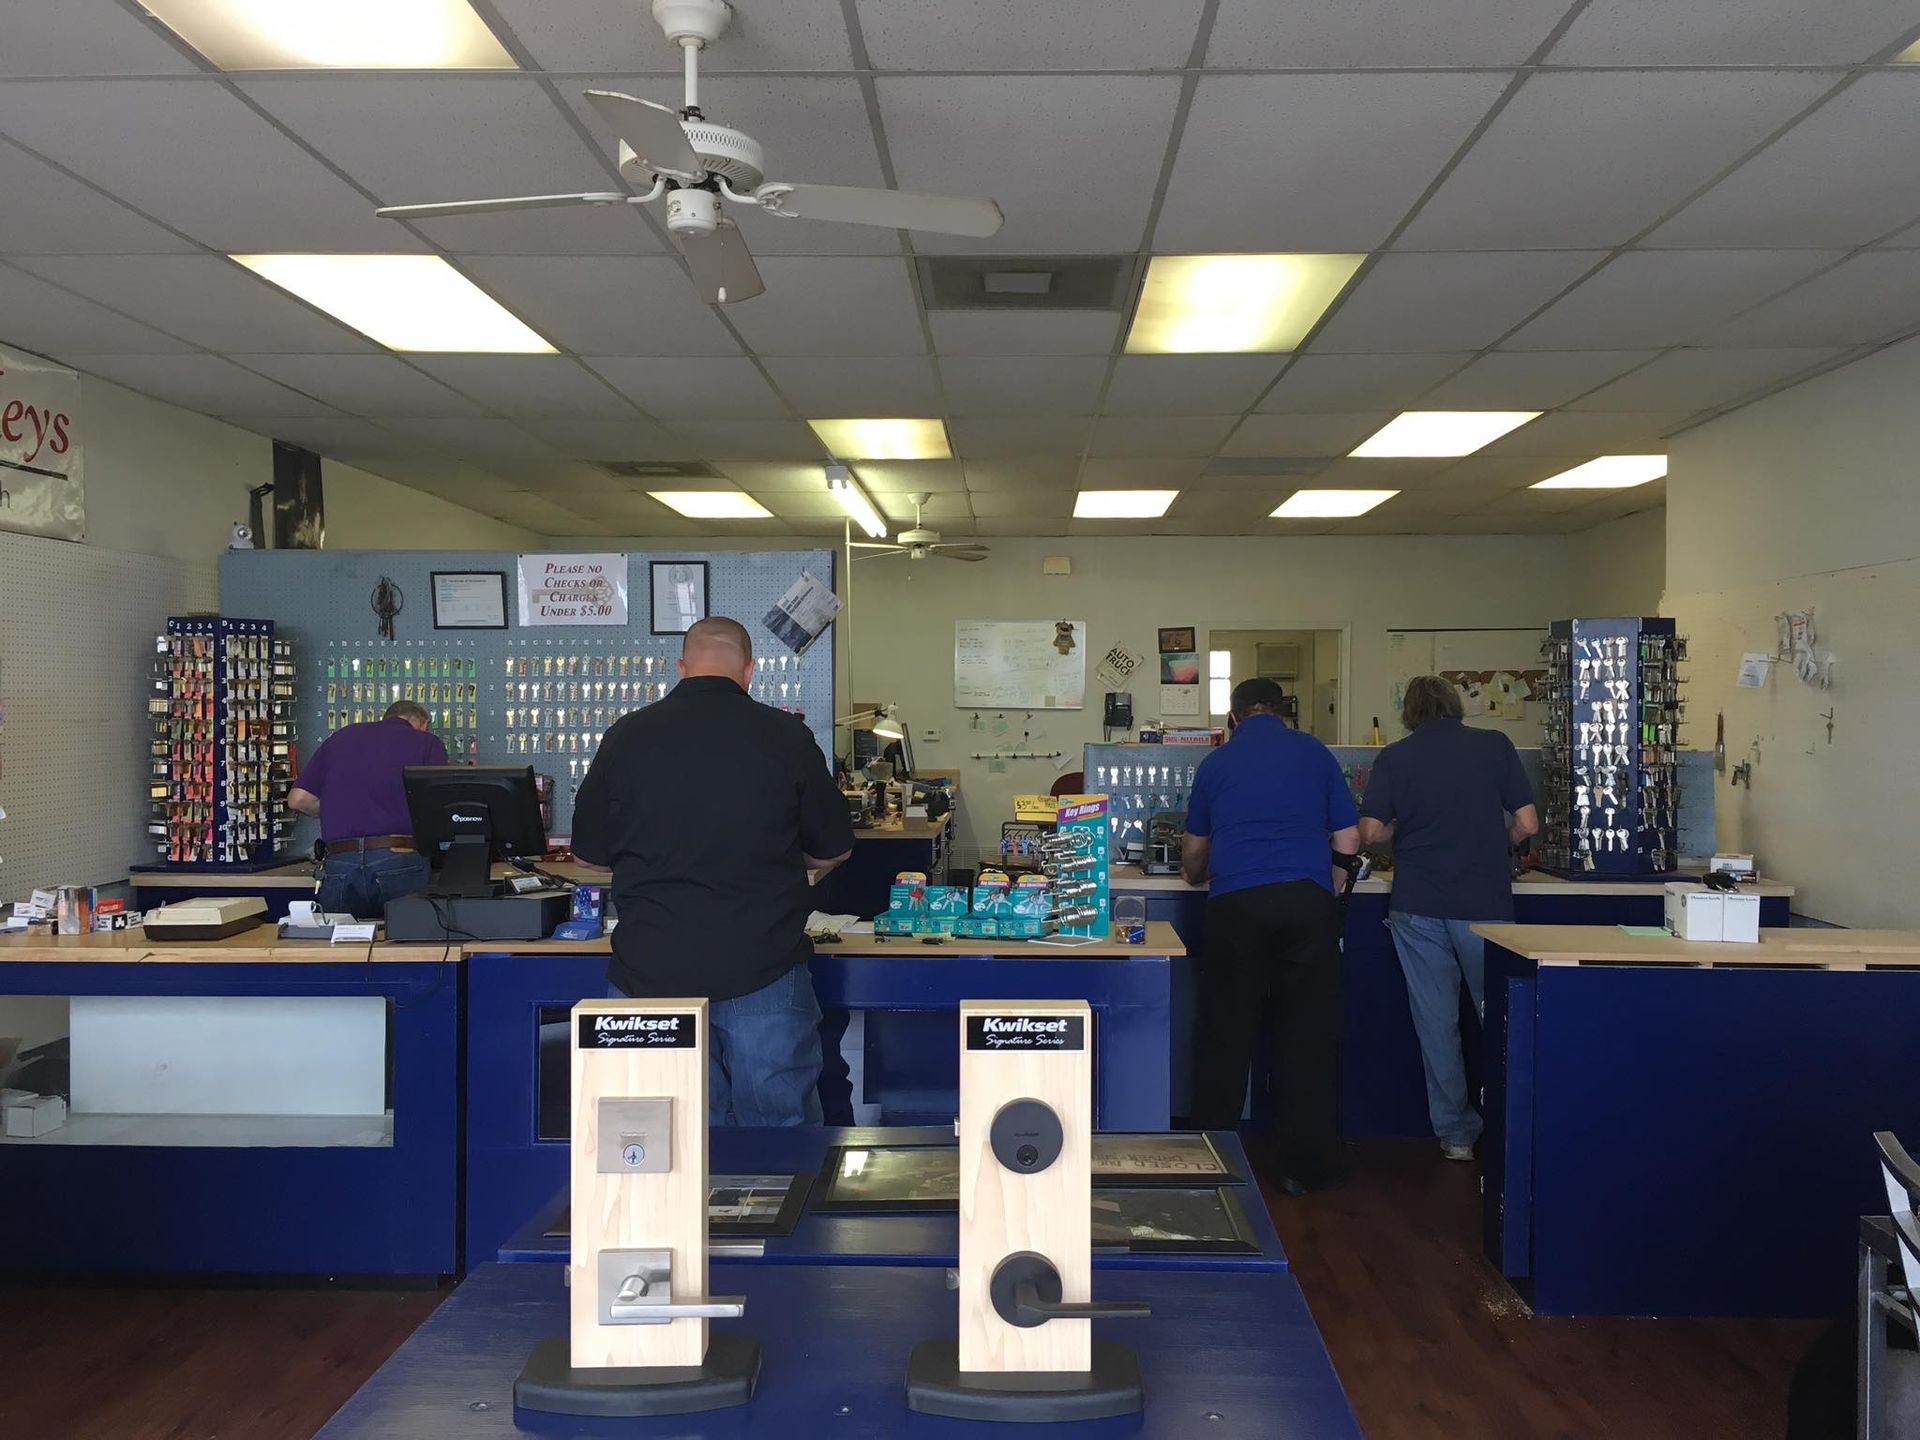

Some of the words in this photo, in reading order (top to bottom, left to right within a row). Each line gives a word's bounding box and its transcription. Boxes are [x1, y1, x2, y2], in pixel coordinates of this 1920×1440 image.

[0, 399, 69, 462] eys
[544, 563, 584, 574] PLEASE
[588, 565, 602, 574] NO
[544, 577, 586, 588] CHECKS
[589, 579, 604, 588] OR
[550, 592, 599, 602] CHARGES
[540, 606, 576, 617] UNDER
[580, 604, 612, 617] $5.00
[1572, 619, 1578, 634] C
[1110, 648, 1134, 668] AUTO
[1064, 807, 1078, 818] Key
[1078, 803, 1100, 814] Rings
[594, 1016, 680, 1030] Kwikset
[983, 1018, 1068, 1032] Kwikset
[598, 1032, 645, 1046] Signature
[647, 1032, 676, 1044] Series
[985, 1034, 1033, 1048] Signature
[1035, 1034, 1064, 1045] Series
